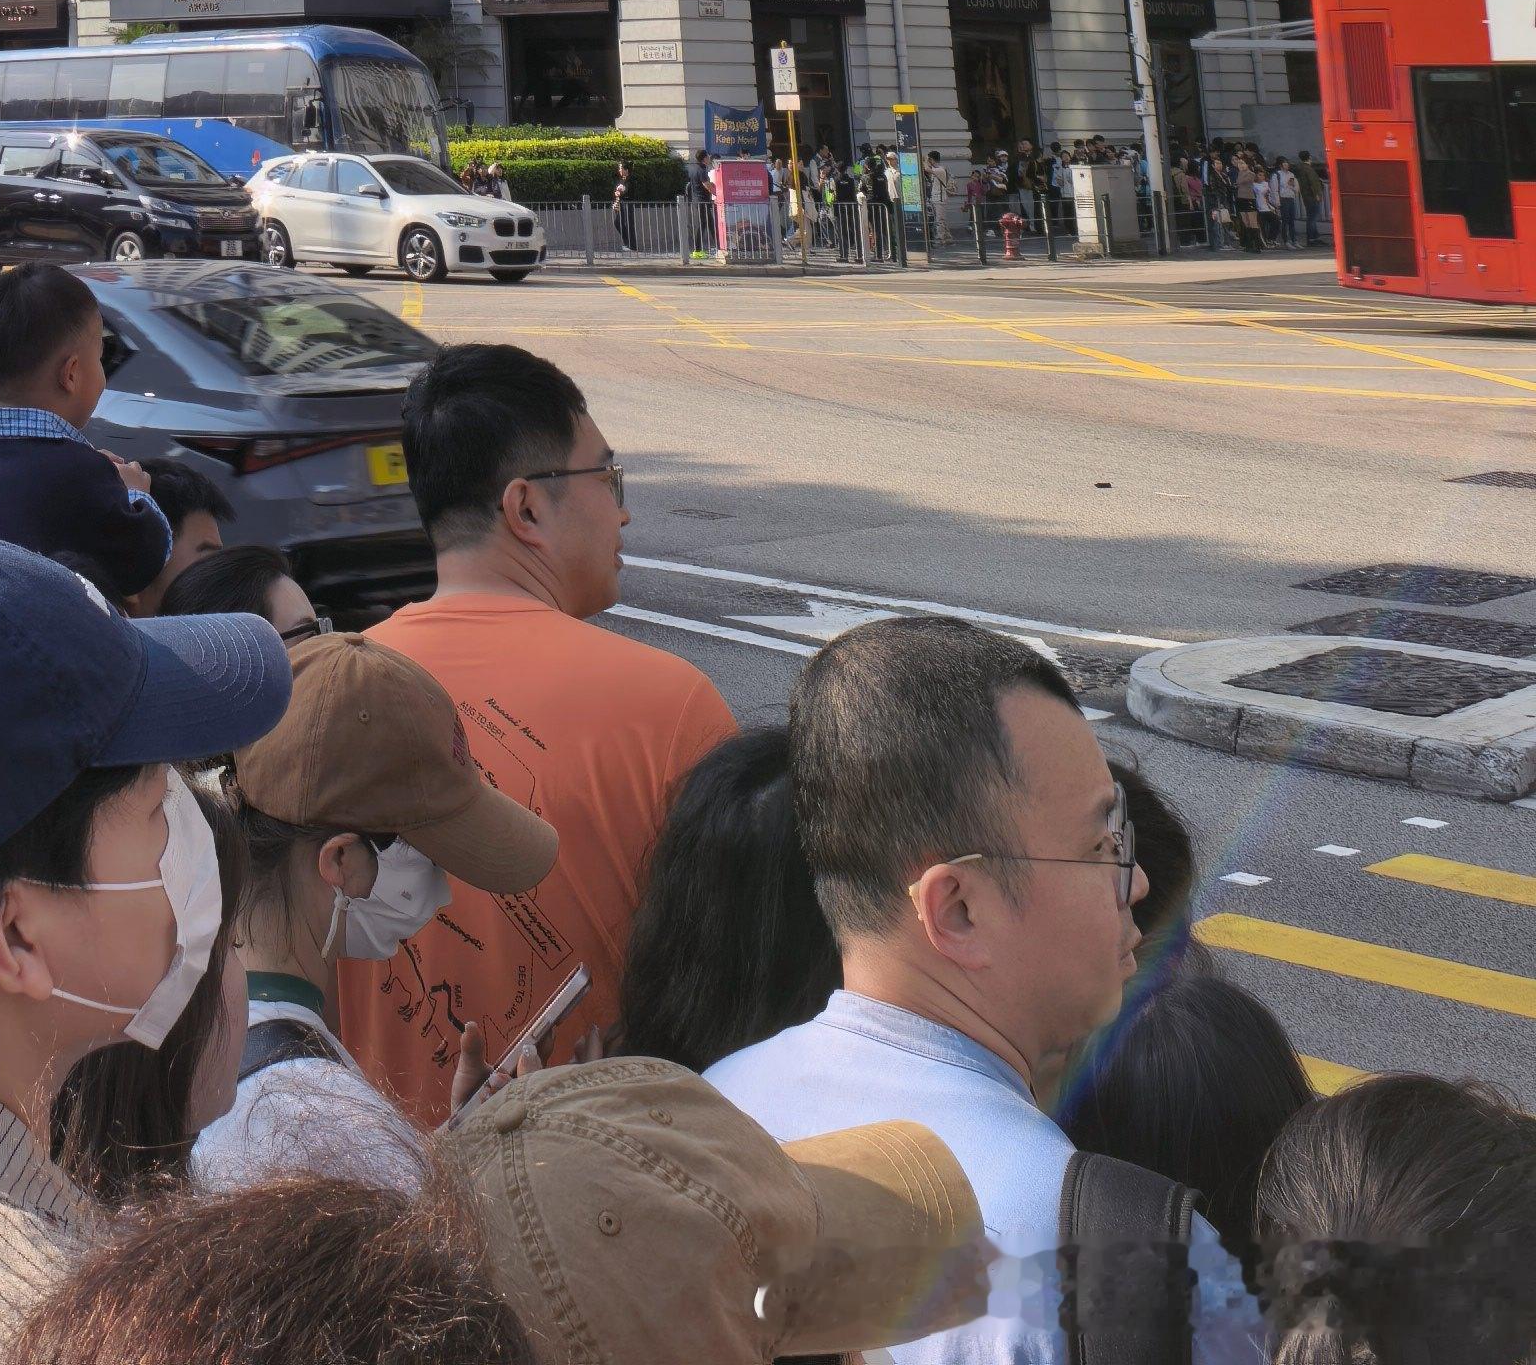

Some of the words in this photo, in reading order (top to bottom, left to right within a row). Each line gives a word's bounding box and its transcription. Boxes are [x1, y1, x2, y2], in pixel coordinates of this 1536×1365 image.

[1144, 2, 1166, 15] OUIS
[715, 133, 736, 146] Keep
[476, 713, 487, 725] TO
[486, 721, 508, 740] SEPT
[436, 913, 485, 952] Serengeti
[505, 900, 517, 912] of
[514, 912, 548, 955] animals
[520, 903, 562, 952] migration
[518, 964, 527, 987] DEC
